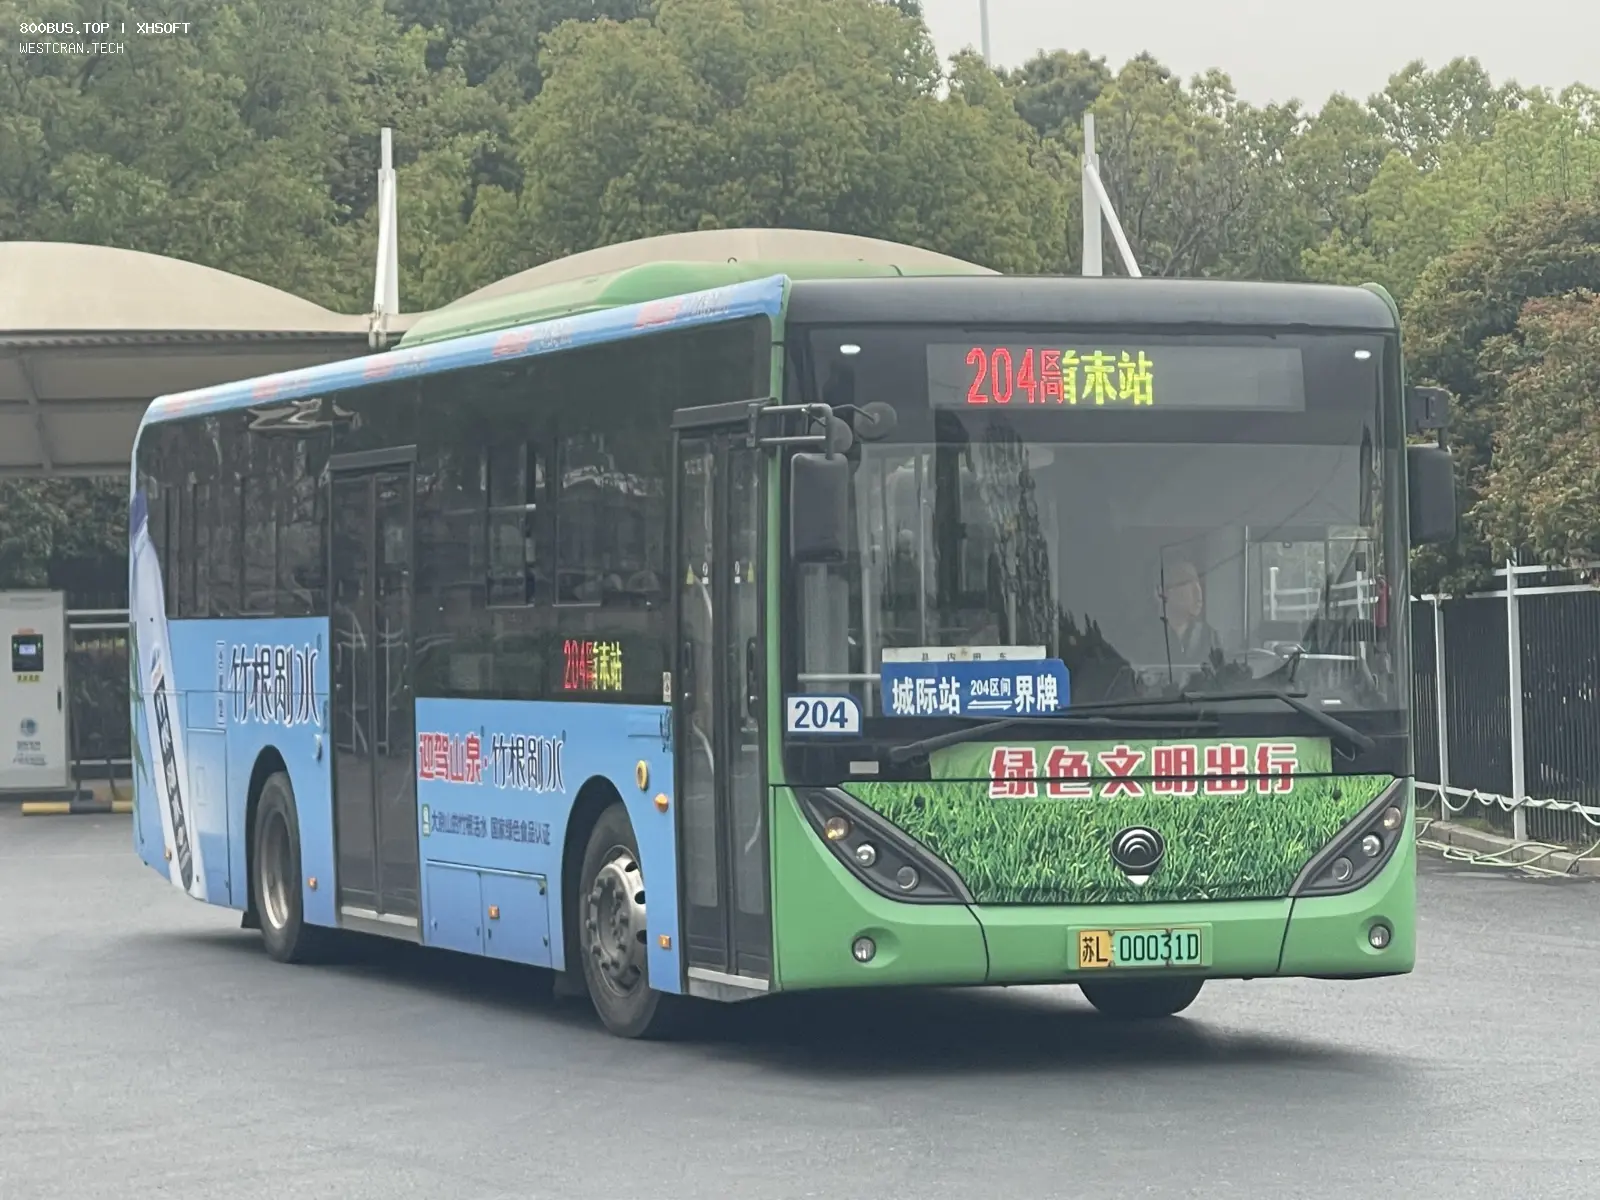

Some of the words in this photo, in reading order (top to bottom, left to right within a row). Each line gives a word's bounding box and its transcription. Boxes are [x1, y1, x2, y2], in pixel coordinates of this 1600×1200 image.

[892, 676, 961, 715] 城际站
[1014, 674, 1059, 713] 界牌
[970, 679, 1011, 697] 204区间
[794, 701, 848, 729] 204
[989, 743, 1297, 799] 绿色文明出行
[1119, 933, 1199, 962] 00031D
